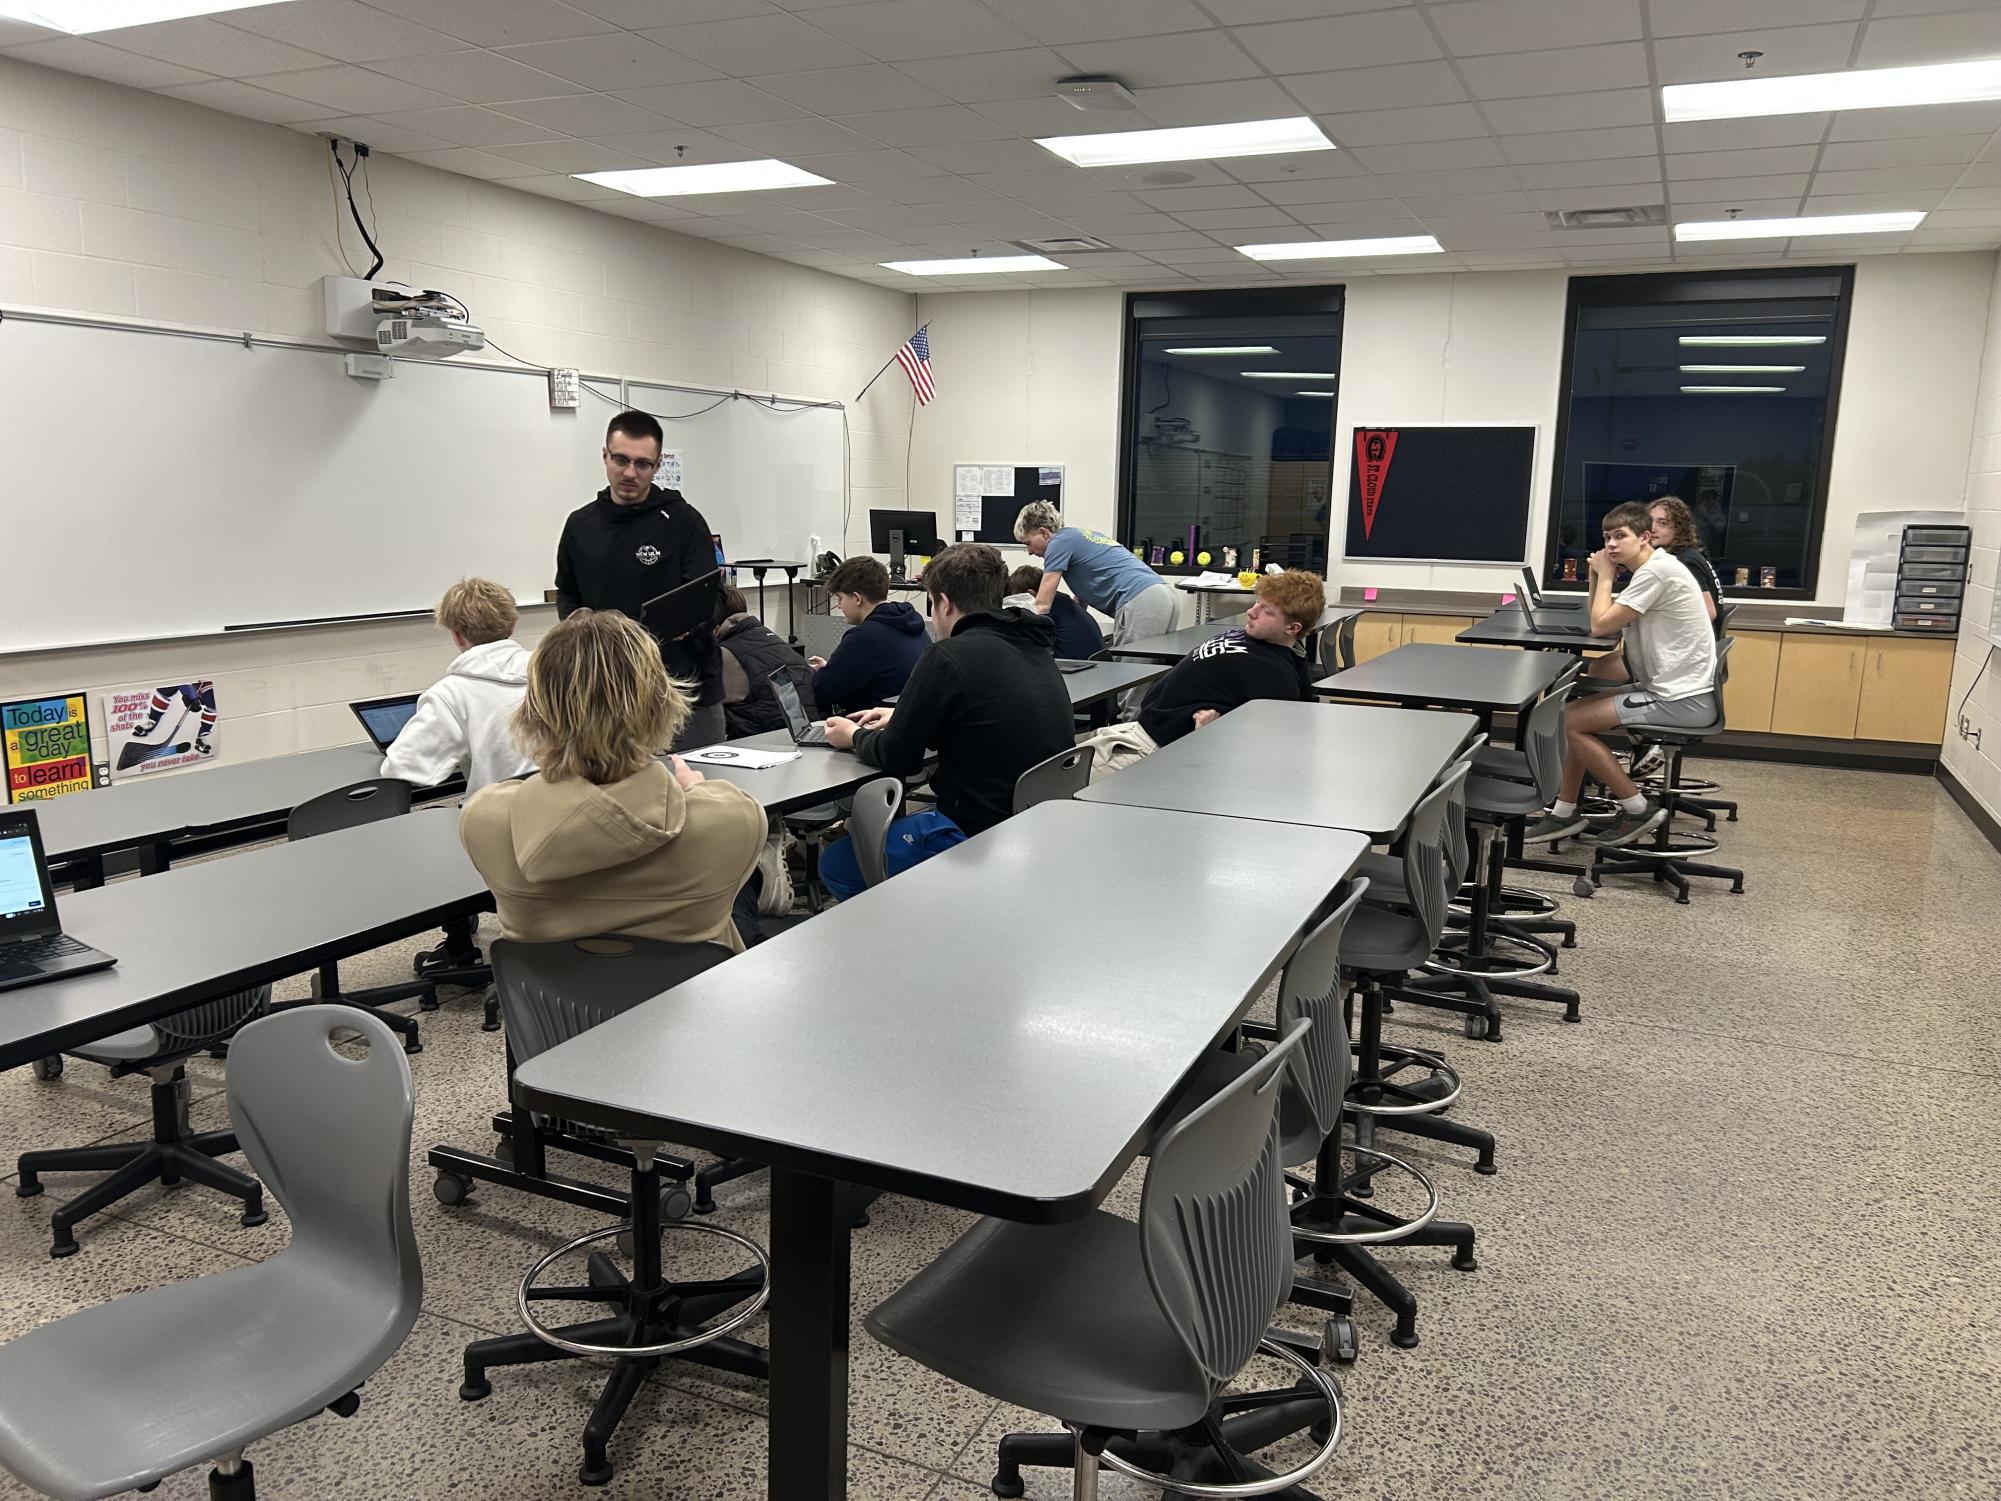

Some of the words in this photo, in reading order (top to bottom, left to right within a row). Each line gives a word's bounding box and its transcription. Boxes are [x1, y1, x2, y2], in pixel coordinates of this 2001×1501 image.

[1366, 474, 1378, 496] CLOUD
[113, 695, 129, 703] You
[130, 692, 150, 701] miss
[6, 705, 65, 726] Today
[68, 708, 78, 718] is
[111, 701, 148, 714] 100%
[118, 713, 129, 722] of
[129, 712, 144, 721] the
[10, 742, 19, 751] a
[25, 720, 82, 752] great
[110, 722, 135, 732] shots
[38, 740, 72, 759] day
[14, 773, 27, 784] to
[27, 761, 83, 785] learn
[140, 761, 156, 773] you
[157, 757, 181, 768] never
[18, 780, 89, 802] something
